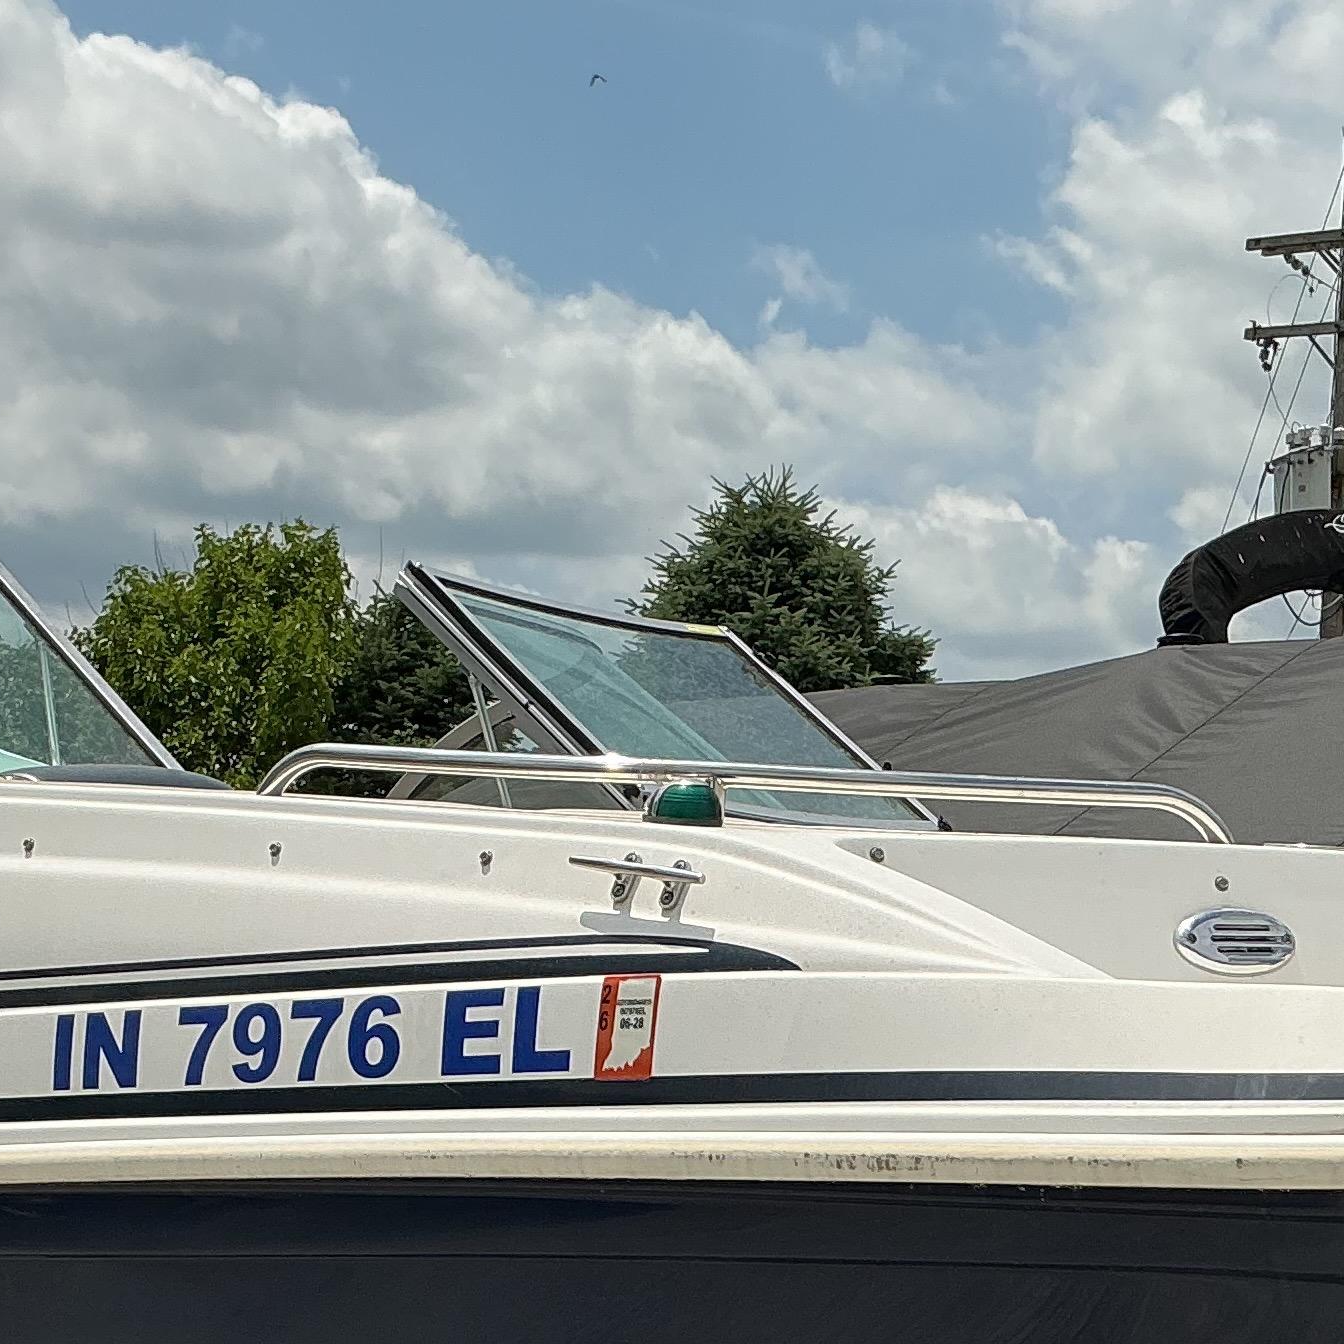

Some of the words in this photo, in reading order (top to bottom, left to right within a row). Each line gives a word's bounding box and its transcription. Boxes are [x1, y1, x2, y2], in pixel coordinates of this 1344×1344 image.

[53, 1010, 142, 1091] IN
[178, 995, 401, 1087] 7976
[440, 986, 571, 1076] EL
